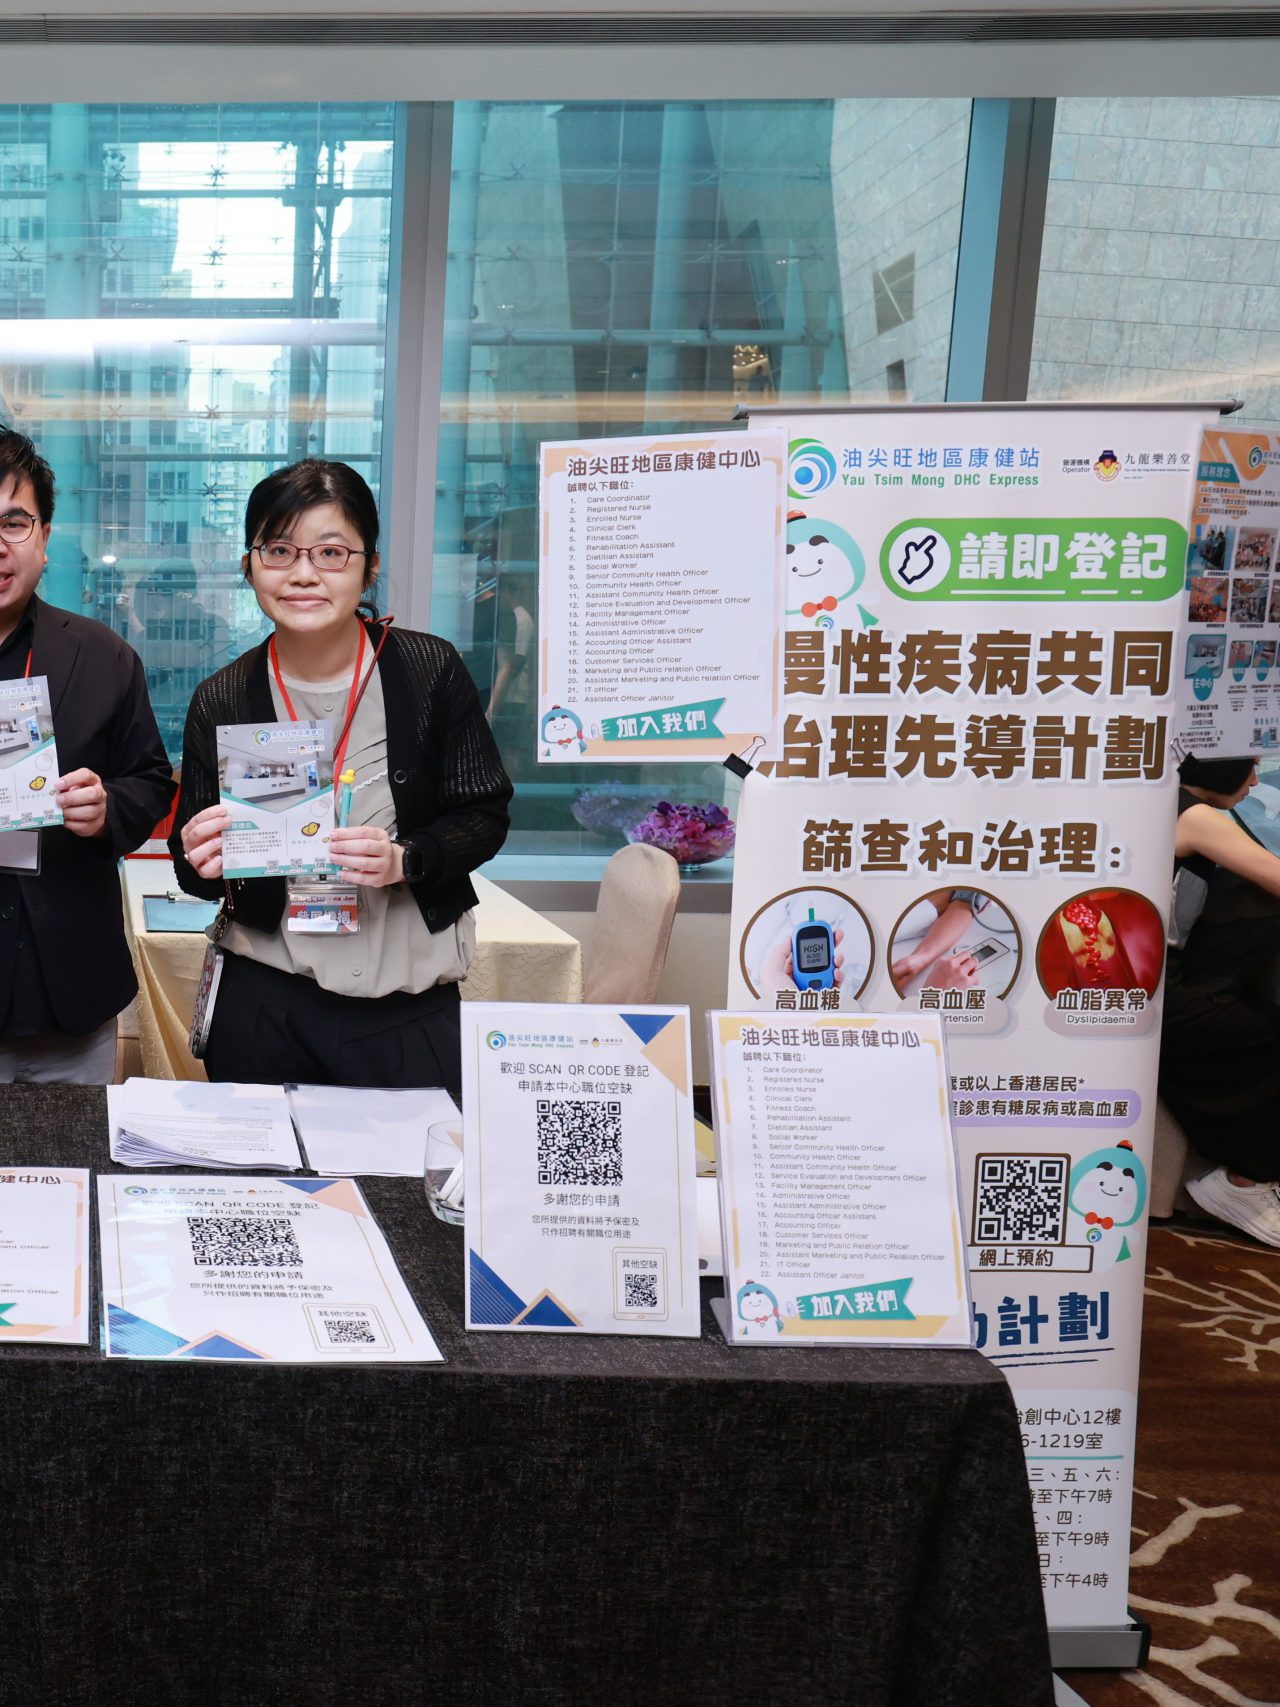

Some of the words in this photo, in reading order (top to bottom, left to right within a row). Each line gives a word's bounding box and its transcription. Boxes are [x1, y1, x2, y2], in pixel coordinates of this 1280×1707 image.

[568, 449, 761, 477] 油尖旺地區康健中心
[842, 447, 1040, 469] 油尖旺地區康健站
[1124, 453, 1191, 465] 九龍樂善堂
[1062, 466, 1090, 474] Operator
[842, 474, 865, 485] Yau
[875, 474, 903, 486] Tsim
[912, 474, 945, 488] Mong
[954, 474, 980, 486] DHC
[989, 474, 1039, 488] Express
[587, 496, 605, 504] Care
[606, 494, 651, 503] Coordinator
[586, 505, 627, 513] Registered
[586, 515, 618, 523] Enrolled
[586, 524, 614, 533] Clinical
[615, 533, 639, 541] Coach
[586, 542, 638, 551] Rehabilitation
[640, 541, 675, 549] Assistant
[586, 553, 618, 561] Dietitian
[959, 532, 1167, 580] 請即登記
[586, 562, 609, 570] Social
[586, 572, 610, 580] Senior
[612, 571, 654, 580] Community
[615, 599, 654, 607] Evaluation
[672, 597, 722, 607] Development
[724, 596, 751, 604] Officer
[595, 685, 618, 693] officer
[617, 710, 707, 737] 加入我們
[803, 944, 824, 953] HIGH
[775, 989, 841, 1011] 高血糖
[919, 989, 986, 1011] 高血壓
[1056, 990, 1148, 1011] 血脂異常
[1066, 1013, 1135, 1025] Dyslipidaemia
[742, 1028, 920, 1048] 油尖旺地區康健中心
[500, 1061, 526, 1075] 歡迎
[529, 1063, 562, 1075] SCAN
[568, 1064, 585, 1076] QR
[588, 1064, 621, 1077] CODE
[624, 1064, 650, 1077] 登記
[518, 1080, 633, 1095] 申請本中心職位空缺
[246, 1201, 286, 1209] CODE
[543, 1192, 620, 1207] 多謝您的申請
[531, 1214, 639, 1226] 您所提供的資料將予保密及
[541, 1228, 631, 1239] 只作招聘有關職位用途
[811, 1232, 843, 1240] Services
[776, 1251, 809, 1259] Assistant
[811, 1252, 847, 1260] Marketing
[889, 1253, 919, 1261] Relation
[979, 1248, 1054, 1267] 網上預約
[622, 1258, 658, 1269] 其他空缺
[203, 1269, 303, 1279] 多謝您的申請
[810, 1289, 899, 1317] 加入我們
